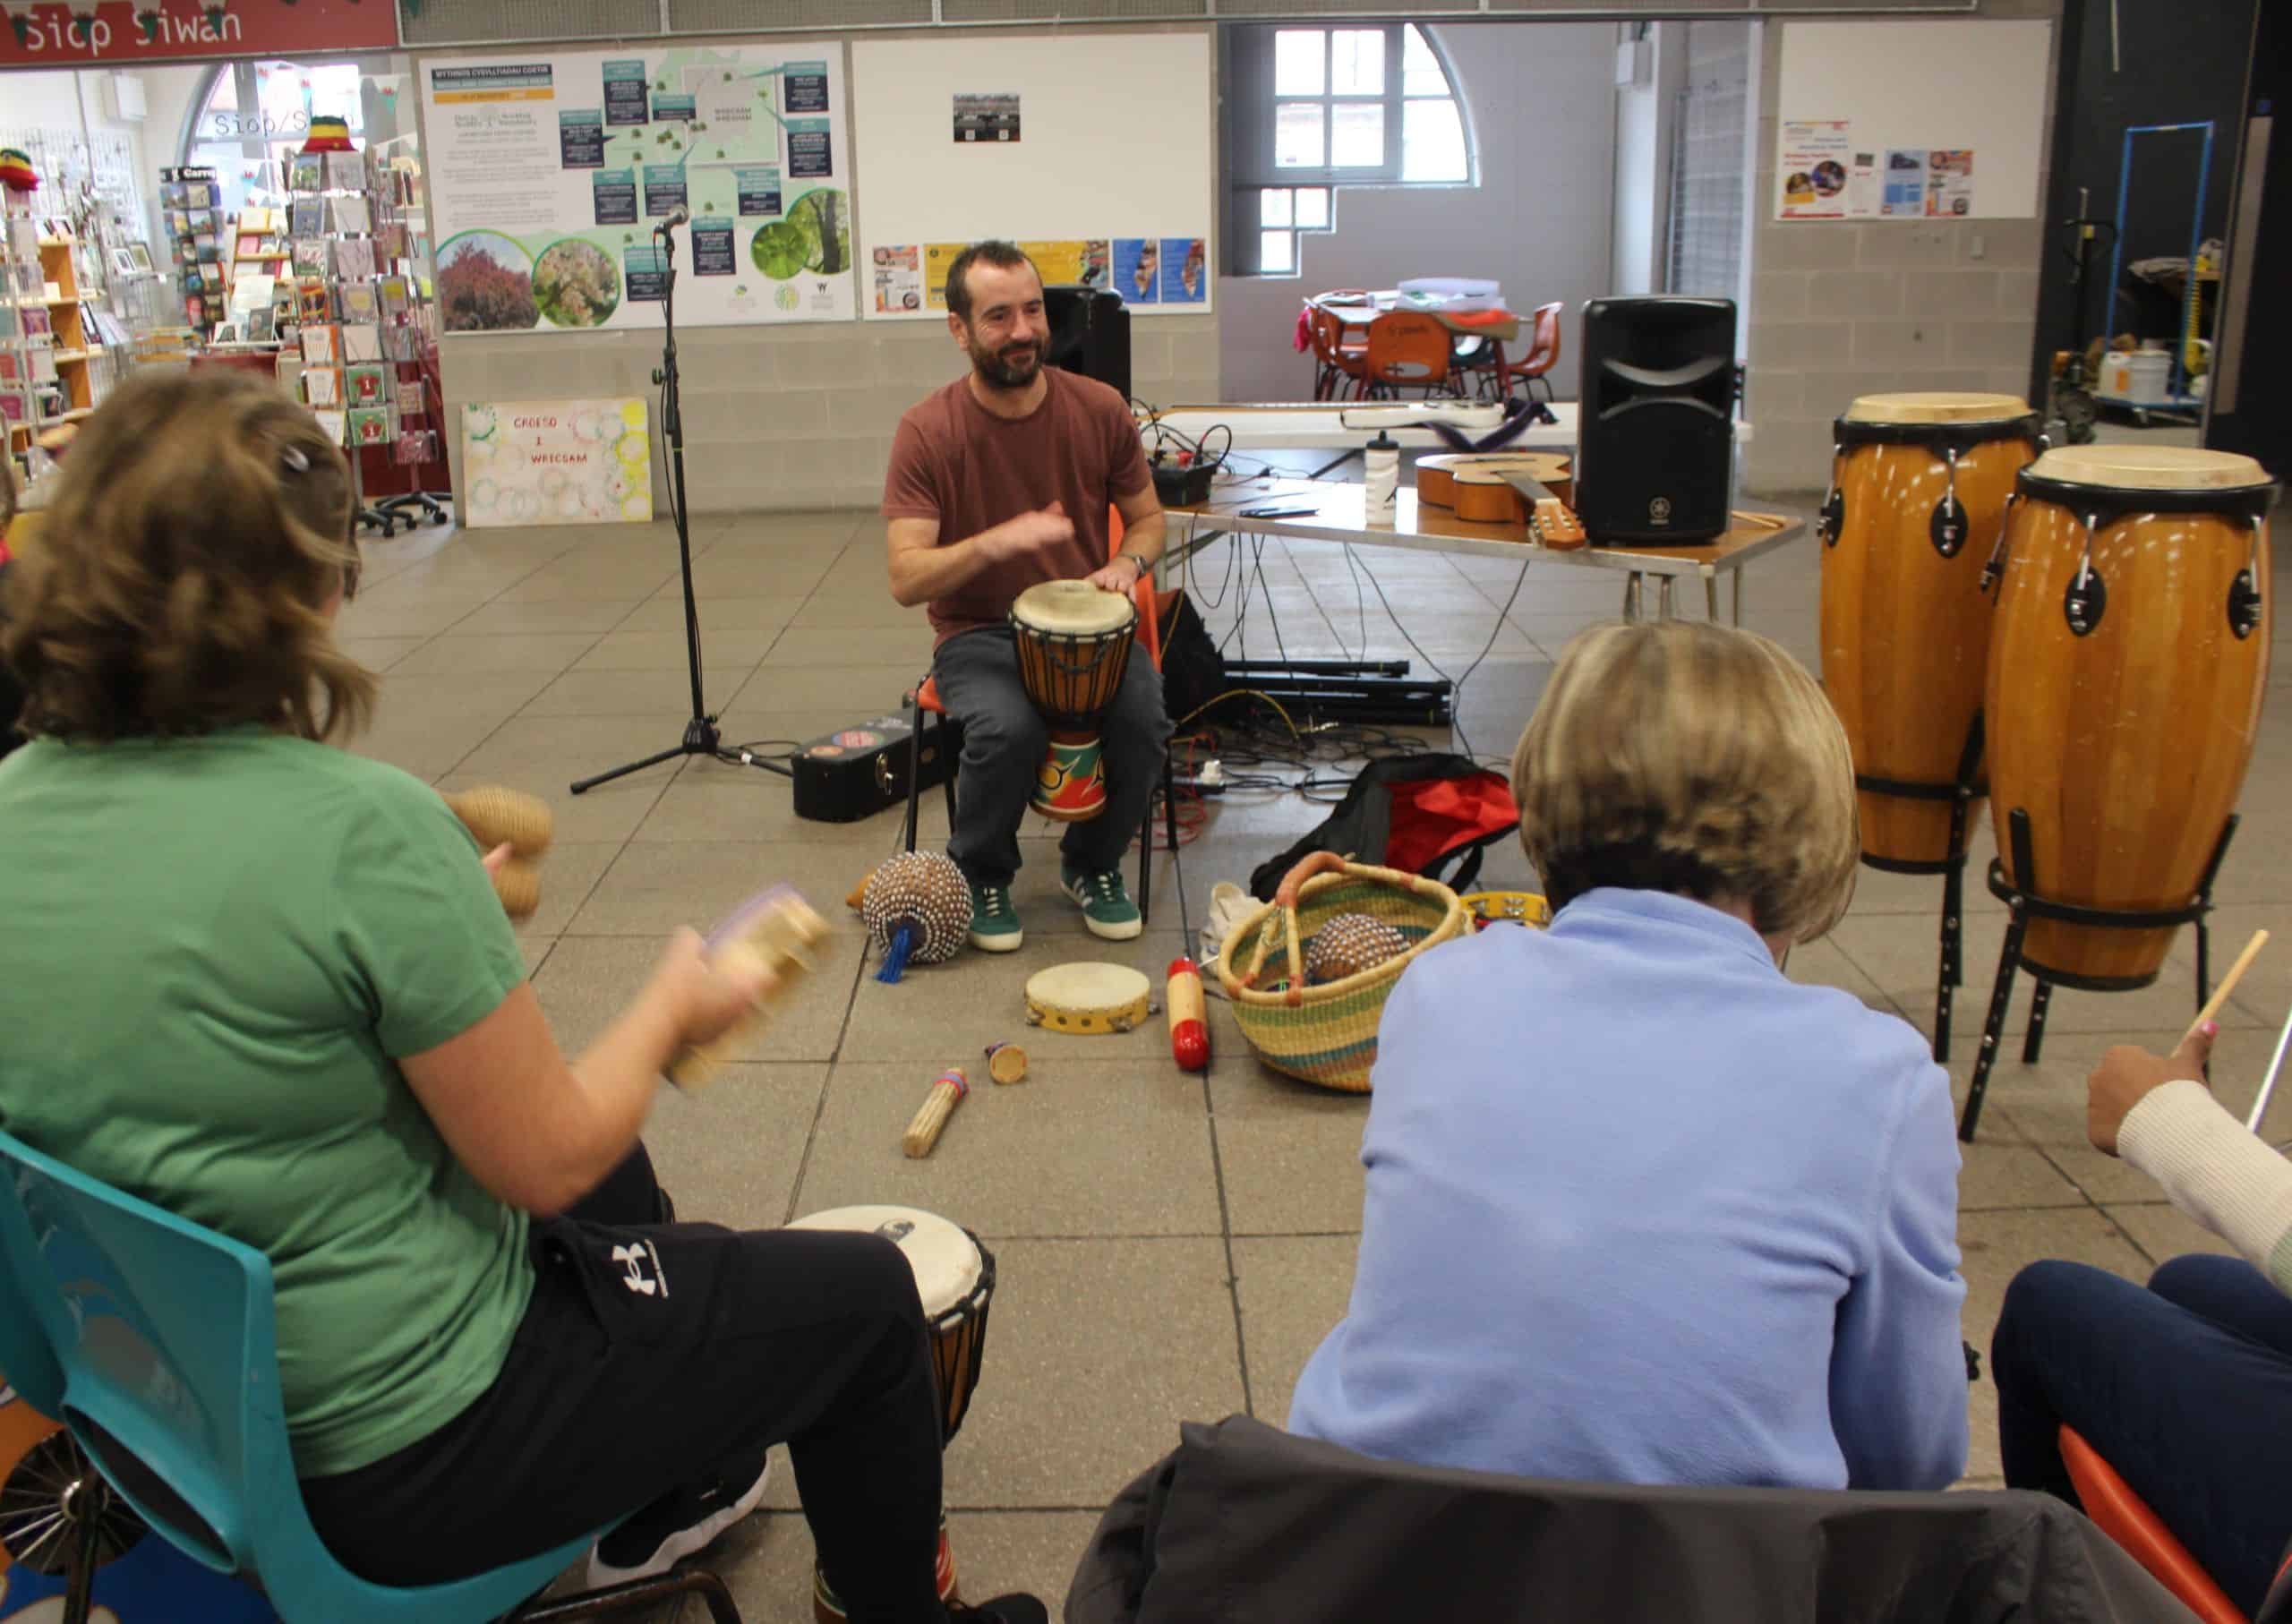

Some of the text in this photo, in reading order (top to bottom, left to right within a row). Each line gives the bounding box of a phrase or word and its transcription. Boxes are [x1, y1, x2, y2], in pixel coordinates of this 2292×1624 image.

[26, 8, 242, 56] Siop Siwan
[215, 109, 355, 137] Siop/S
[514, 417, 557, 429] CROESO
[531, 452, 588, 465] WRECSAM
